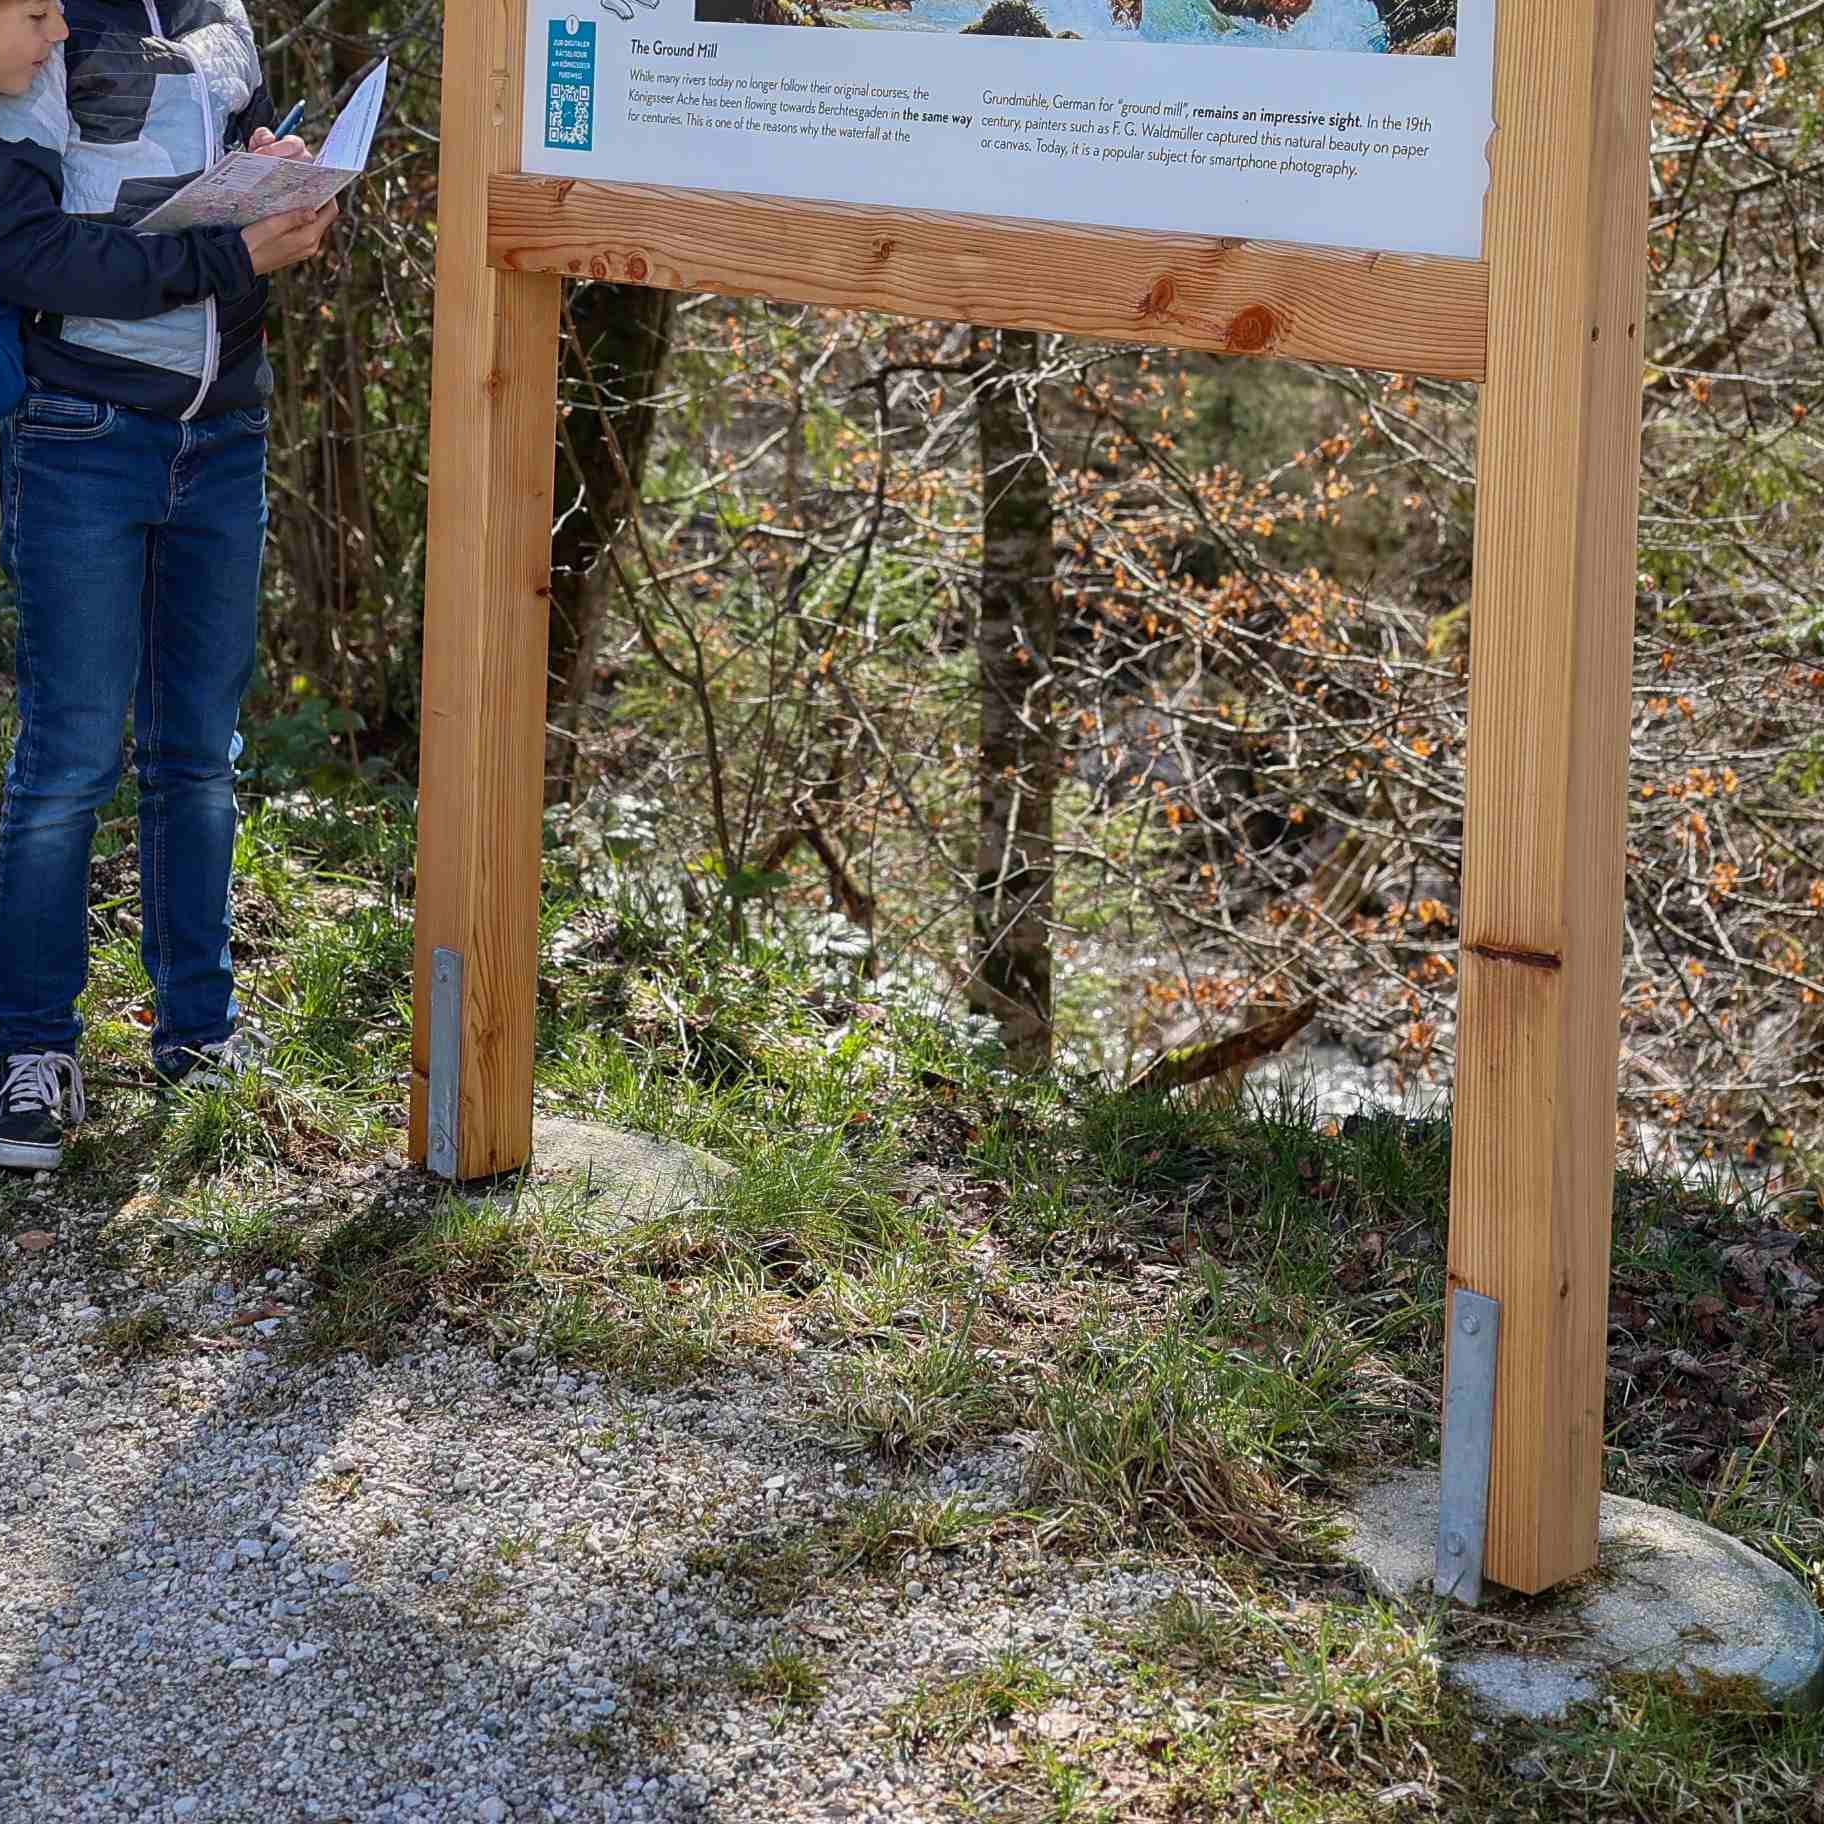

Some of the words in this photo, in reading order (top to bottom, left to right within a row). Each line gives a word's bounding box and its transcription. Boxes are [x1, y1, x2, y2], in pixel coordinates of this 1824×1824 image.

[630, 38, 650, 55] The
[652, 39, 696, 58] Ground
[696, 42, 718, 59] Mill
[629, 68, 655, 83] While
[656, 72, 681, 89] many
[681, 71, 707, 87] rivers
[708, 72, 735, 92] today
[735, 79, 748, 89] no
[749, 74, 779, 95] longer
[780, 76, 809, 93] follow
[810, 79, 833, 94] their
[833, 81, 870, 101] original
[912, 85, 930, 101] the
[627, 87, 675, 107] Königsseer
[675, 91, 700, 107] Ache
[701, 92, 718, 108] has
[719, 94, 743, 109] been
[744, 95, 778, 116] flowing
[779, 98, 817, 114] towards
[817, 100, 889, 123] Berchtesgaden
[890, 107, 901, 121] in
[902, 106, 920, 122] the
[921, 112, 949, 124] same
[951, 111, 973, 129] way
[627, 107, 641, 122] for
[686, 111, 705, 128] This
[705, 115, 713, 129] is
[714, 119, 733, 129] one
[733, 116, 745, 130] of
[745, 116, 761, 131] the
[762, 122, 798, 135] reasons
[799, 119, 820, 140] why
[821, 122, 837, 137] the
[838, 123, 881, 141] waterfall
[881, 129, 892, 141] at
[894, 127, 911, 143] the
[1052, 93, 1096, 111] German
[1098, 96, 1115, 112] for
[1192, 104, 1240, 121] remains
[1241, 111, 1257, 121] an
[1259, 107, 1326, 128] impressive
[1328, 111, 1363, 133] sight.
[1367, 113, 1379, 129] In
[1382, 114, 1402, 131] the
[1406, 116, 1432, 133] 19th
[980, 136, 993, 150] or
[993, 135, 1033, 153] canvas.
[1036, 137, 1069, 159] Today,
[1071, 141, 1079, 156] it
[1081, 142, 1091, 157] is
[1092, 144, 1100, 160] a
[1101, 144, 1145, 163] popular
[1146, 145, 1188, 167] subject
[1190, 148, 1208, 165] for
[1209, 151, 1278, 173] smartphone
[1279, 154, 1358, 181] photography.
[1024, 116, 1068, 134] painters
[1069, 119, 1095, 137] such
[1096, 124, 1110, 135] as
[1141, 121, 1205, 141] Waldmüller
[1206, 129, 1259, 148] captured
[1260, 130, 1282, 147] this
[1284, 134, 1327, 150] natural
[1328, 135, 1371, 157] beauty
[1372, 143, 1390, 154] on
[1391, 144, 1430, 161] paper
